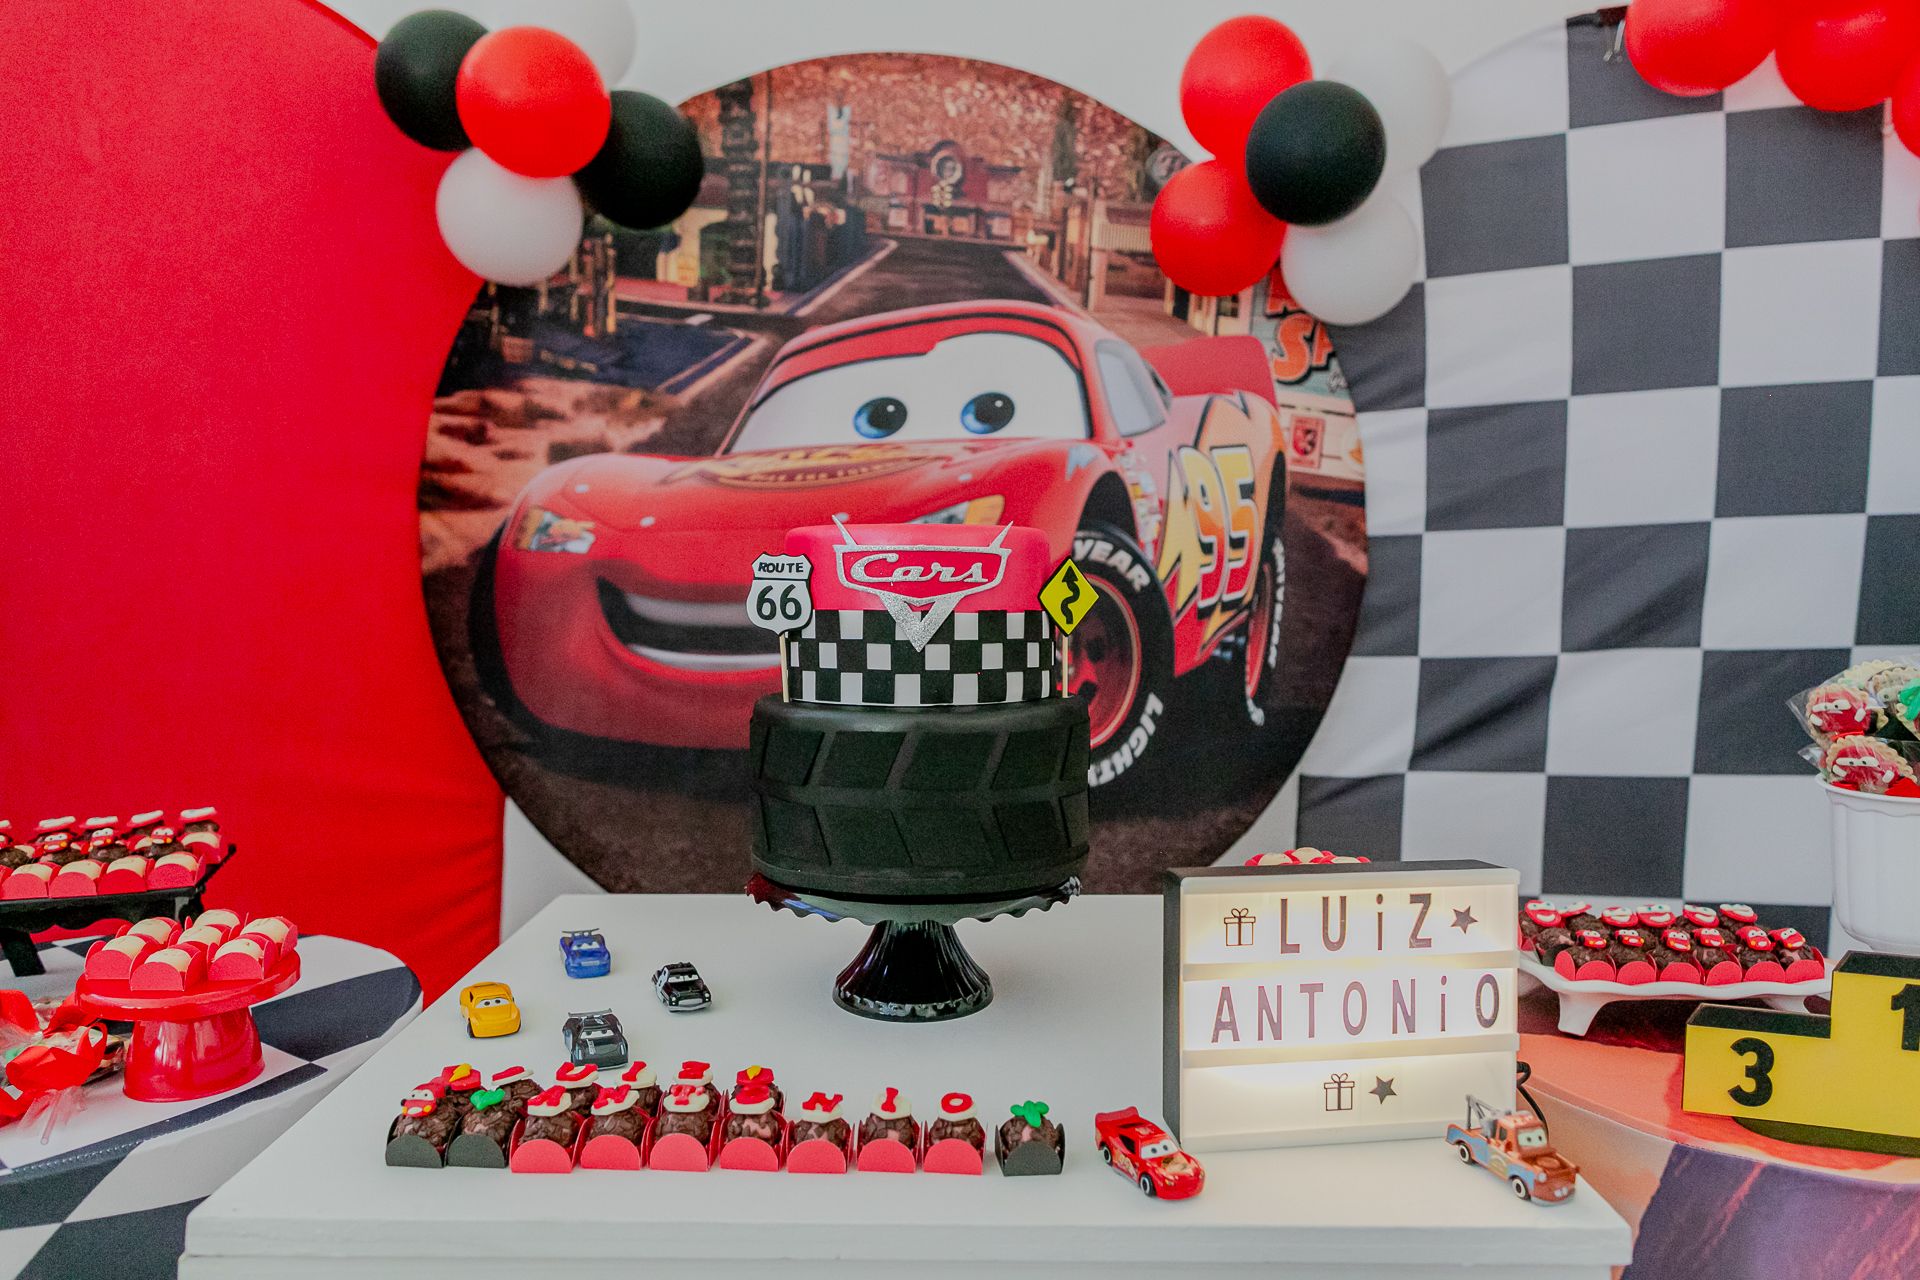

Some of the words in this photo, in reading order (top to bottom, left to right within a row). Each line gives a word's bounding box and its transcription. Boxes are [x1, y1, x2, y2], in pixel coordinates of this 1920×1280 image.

[1180, 445, 1259, 608] 95
[758, 562, 804, 573] ROUTE
[850, 553, 988, 584] Cars
[756, 584, 802, 621] 66
[1890, 984, 1920, 1051] 1
[1727, 1037, 1775, 1107] 3
